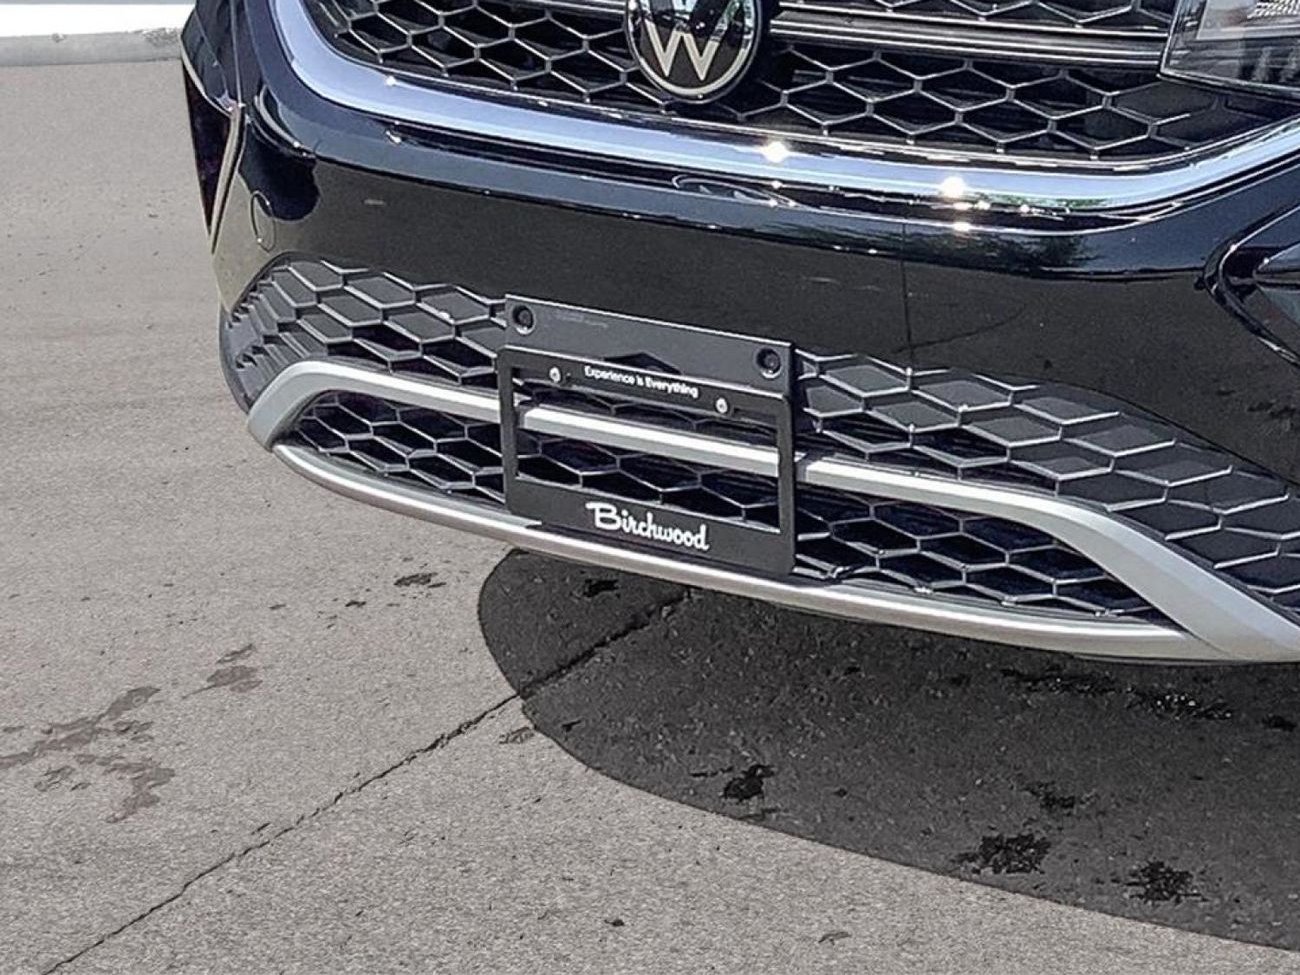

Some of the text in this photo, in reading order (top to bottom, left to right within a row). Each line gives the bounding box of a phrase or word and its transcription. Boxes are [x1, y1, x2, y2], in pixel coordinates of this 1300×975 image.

[584, 365, 636, 386] Experience
[645, 376, 699, 399] Everything
[585, 502, 710, 551] Birchwood
